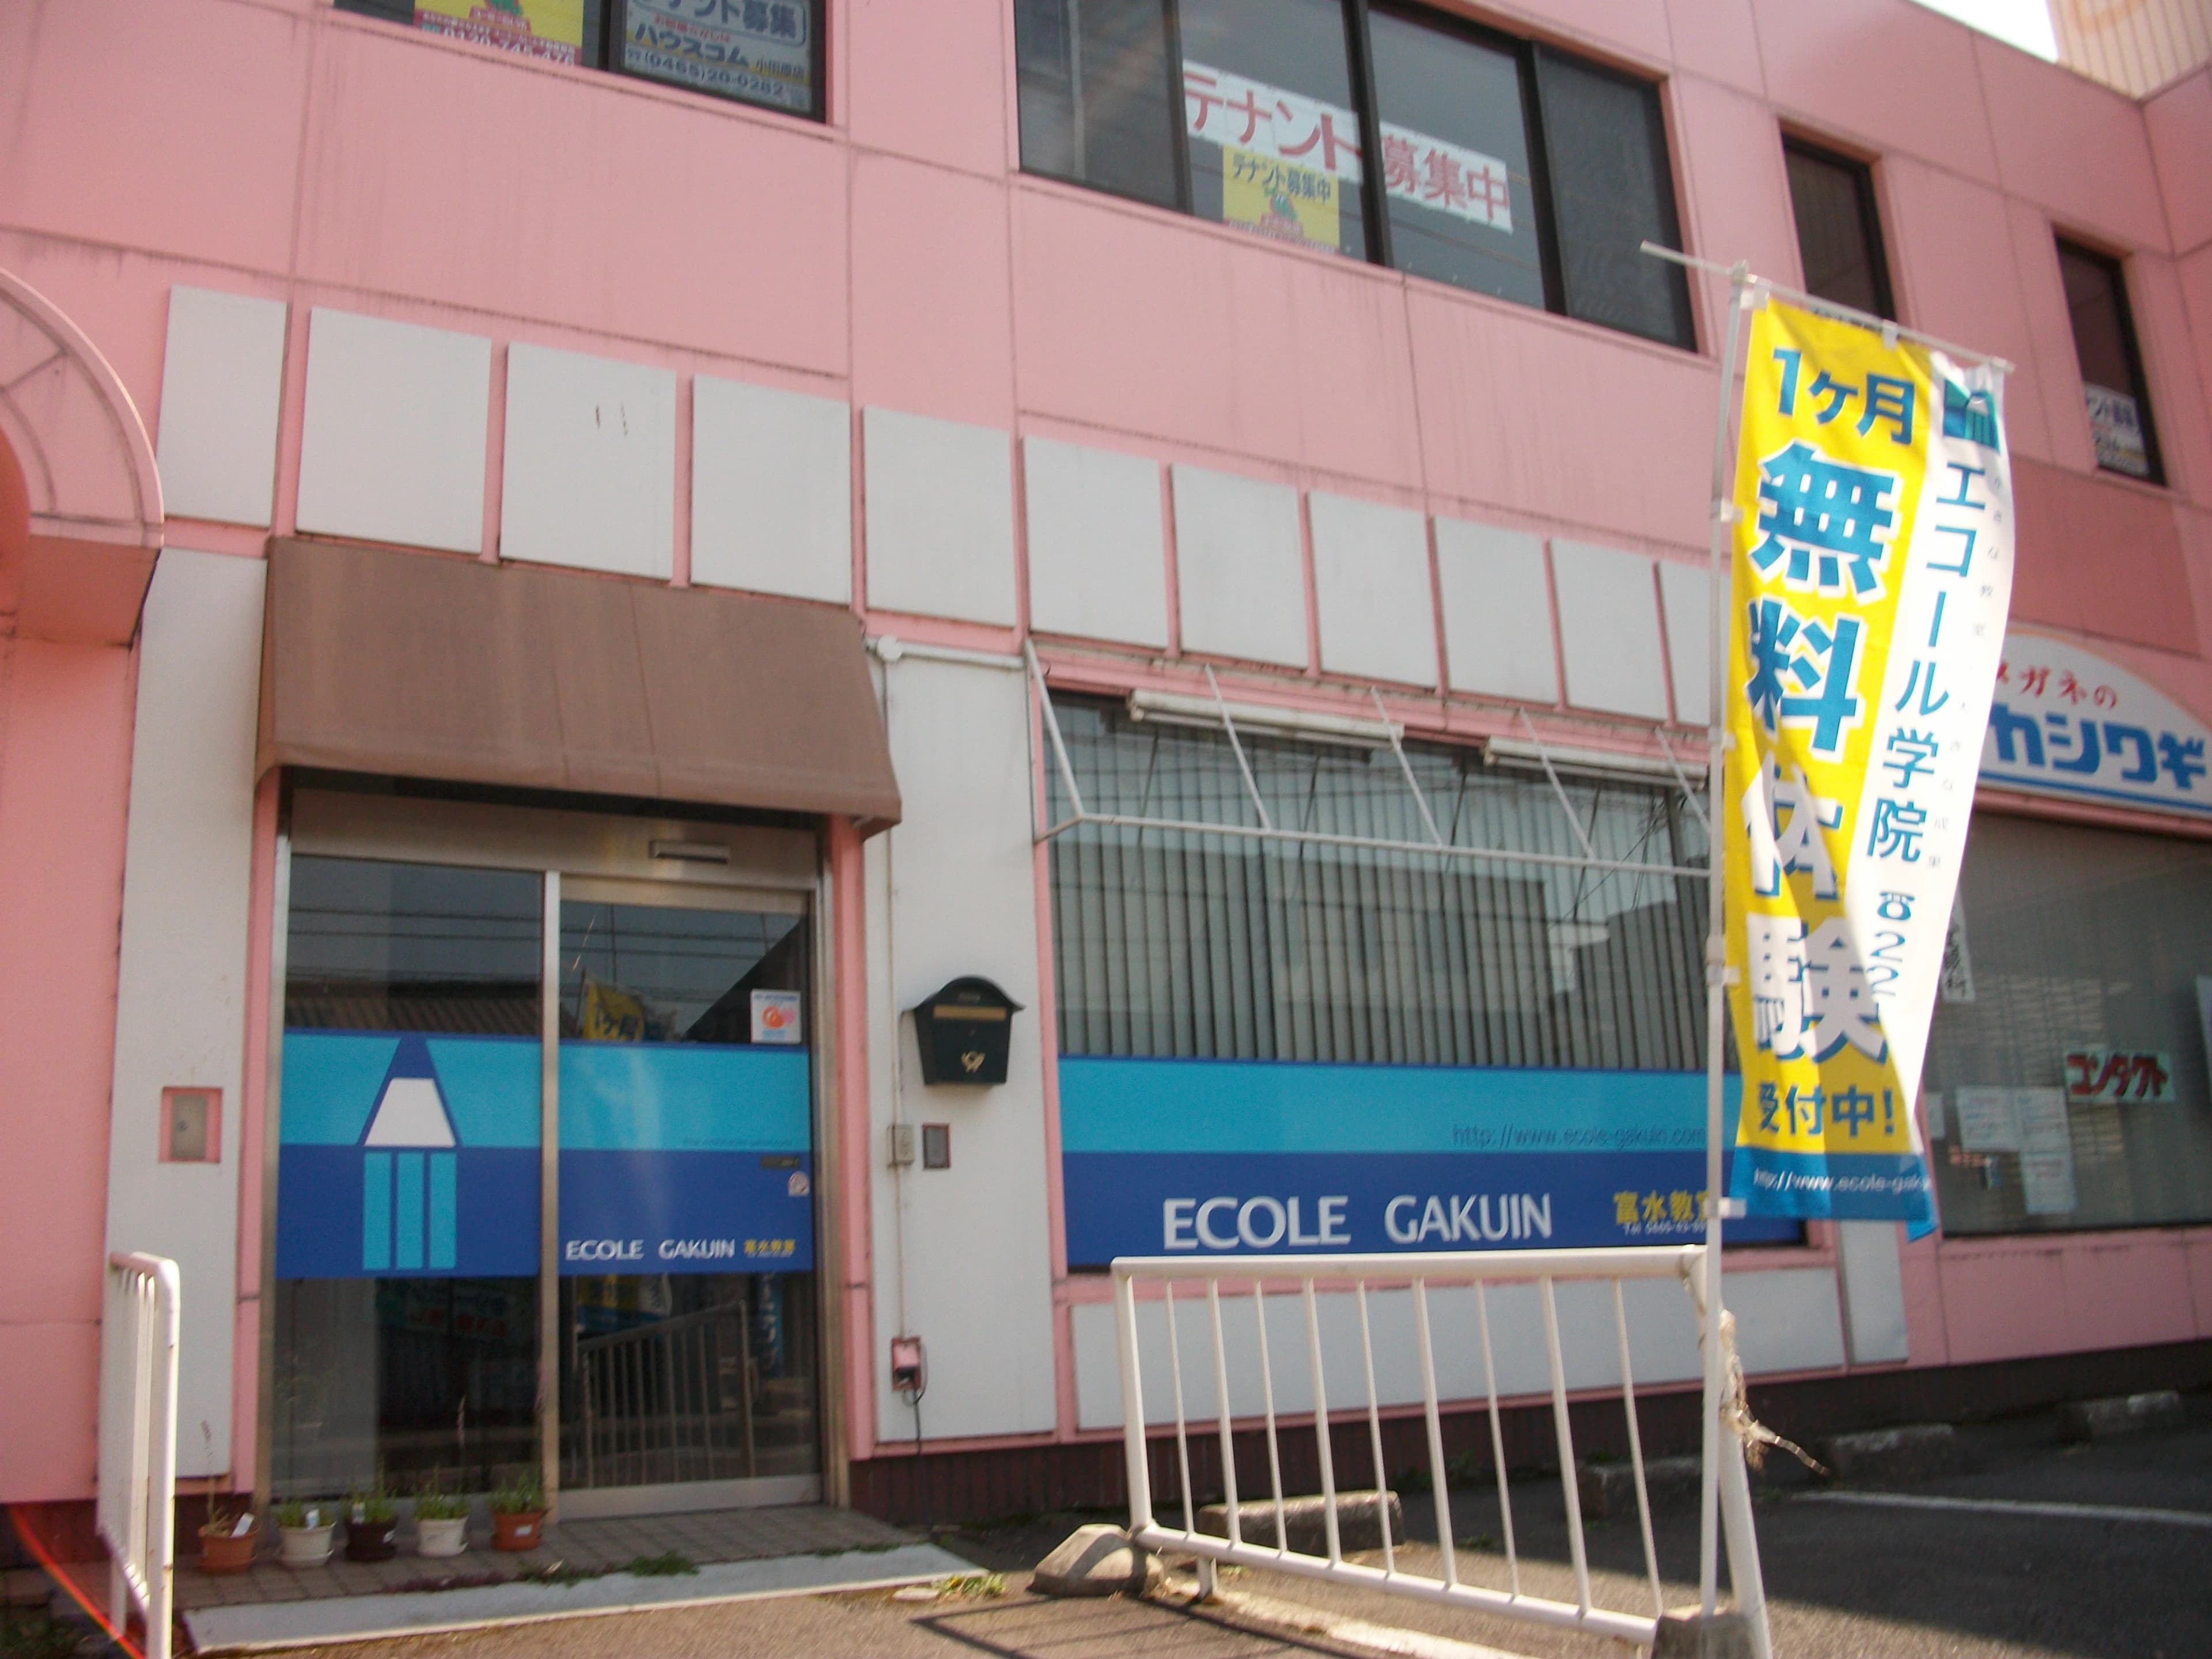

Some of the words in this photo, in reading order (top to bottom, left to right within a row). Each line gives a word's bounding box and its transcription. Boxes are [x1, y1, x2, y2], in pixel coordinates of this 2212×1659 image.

[635, 22, 749, 67] ハウスコム
[1184, 71, 1363, 171] テナント
[1383, 134, 1509, 221] 募集中
[1233, 152, 1331, 204] テナント募集中
[1866, 461, 1986, 863] エコール学院
[1988, 701, 2206, 790] カシワギ
[565, 1240, 645, 1261] ECOLE
[657, 1238, 736, 1259] GAKUIN
[1162, 1195, 1351, 1251] ECOLE
[1384, 1192, 1552, 1244] GAKUIN
